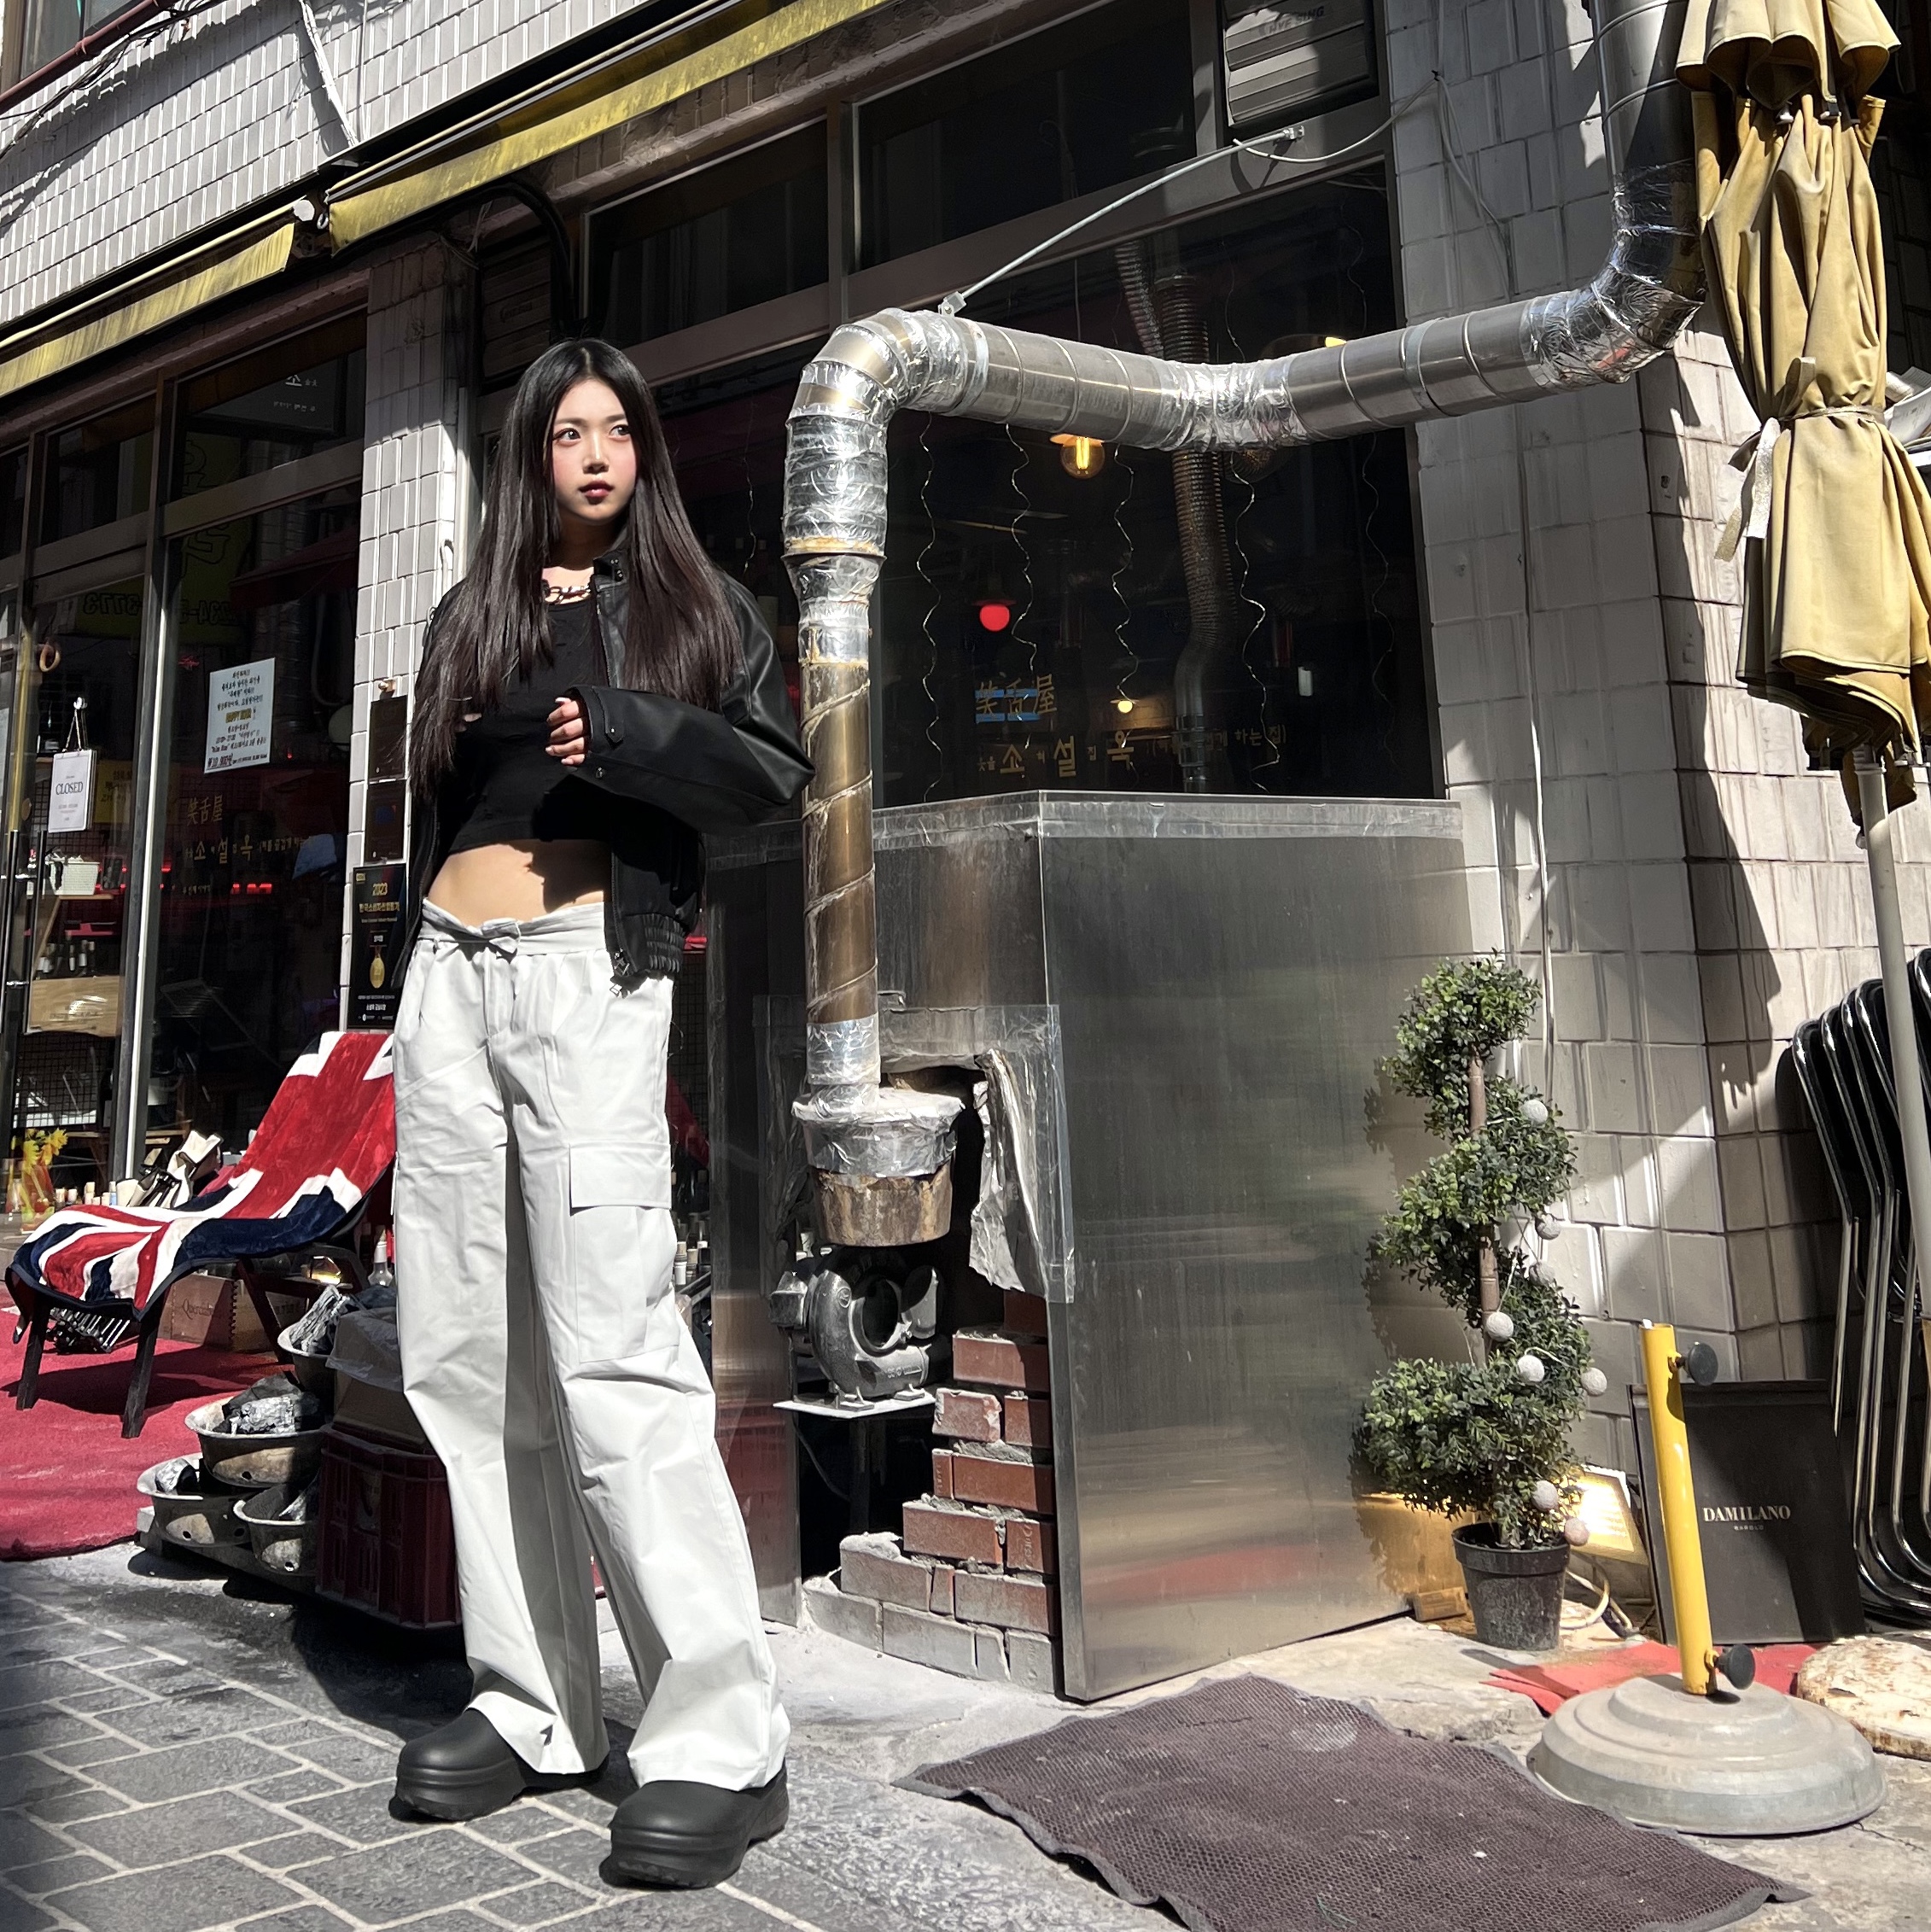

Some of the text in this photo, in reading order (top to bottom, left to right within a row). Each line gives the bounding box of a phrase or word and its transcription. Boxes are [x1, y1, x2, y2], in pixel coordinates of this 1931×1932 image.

[1000, 744, 1025, 775] 소
[1053, 735, 1077, 778] 설
[1106, 730, 1135, 771] 옥
[1234, 727, 1263, 746] 하는
[55, 781, 84, 796] CLOSED
[187, 794, 224, 826] 笑舌屋
[194, 840, 207, 861] 소
[218, 835, 228, 865] 설
[240, 834, 254, 861] 옥
[1702, 1505, 1791, 1523] DAMILANO
